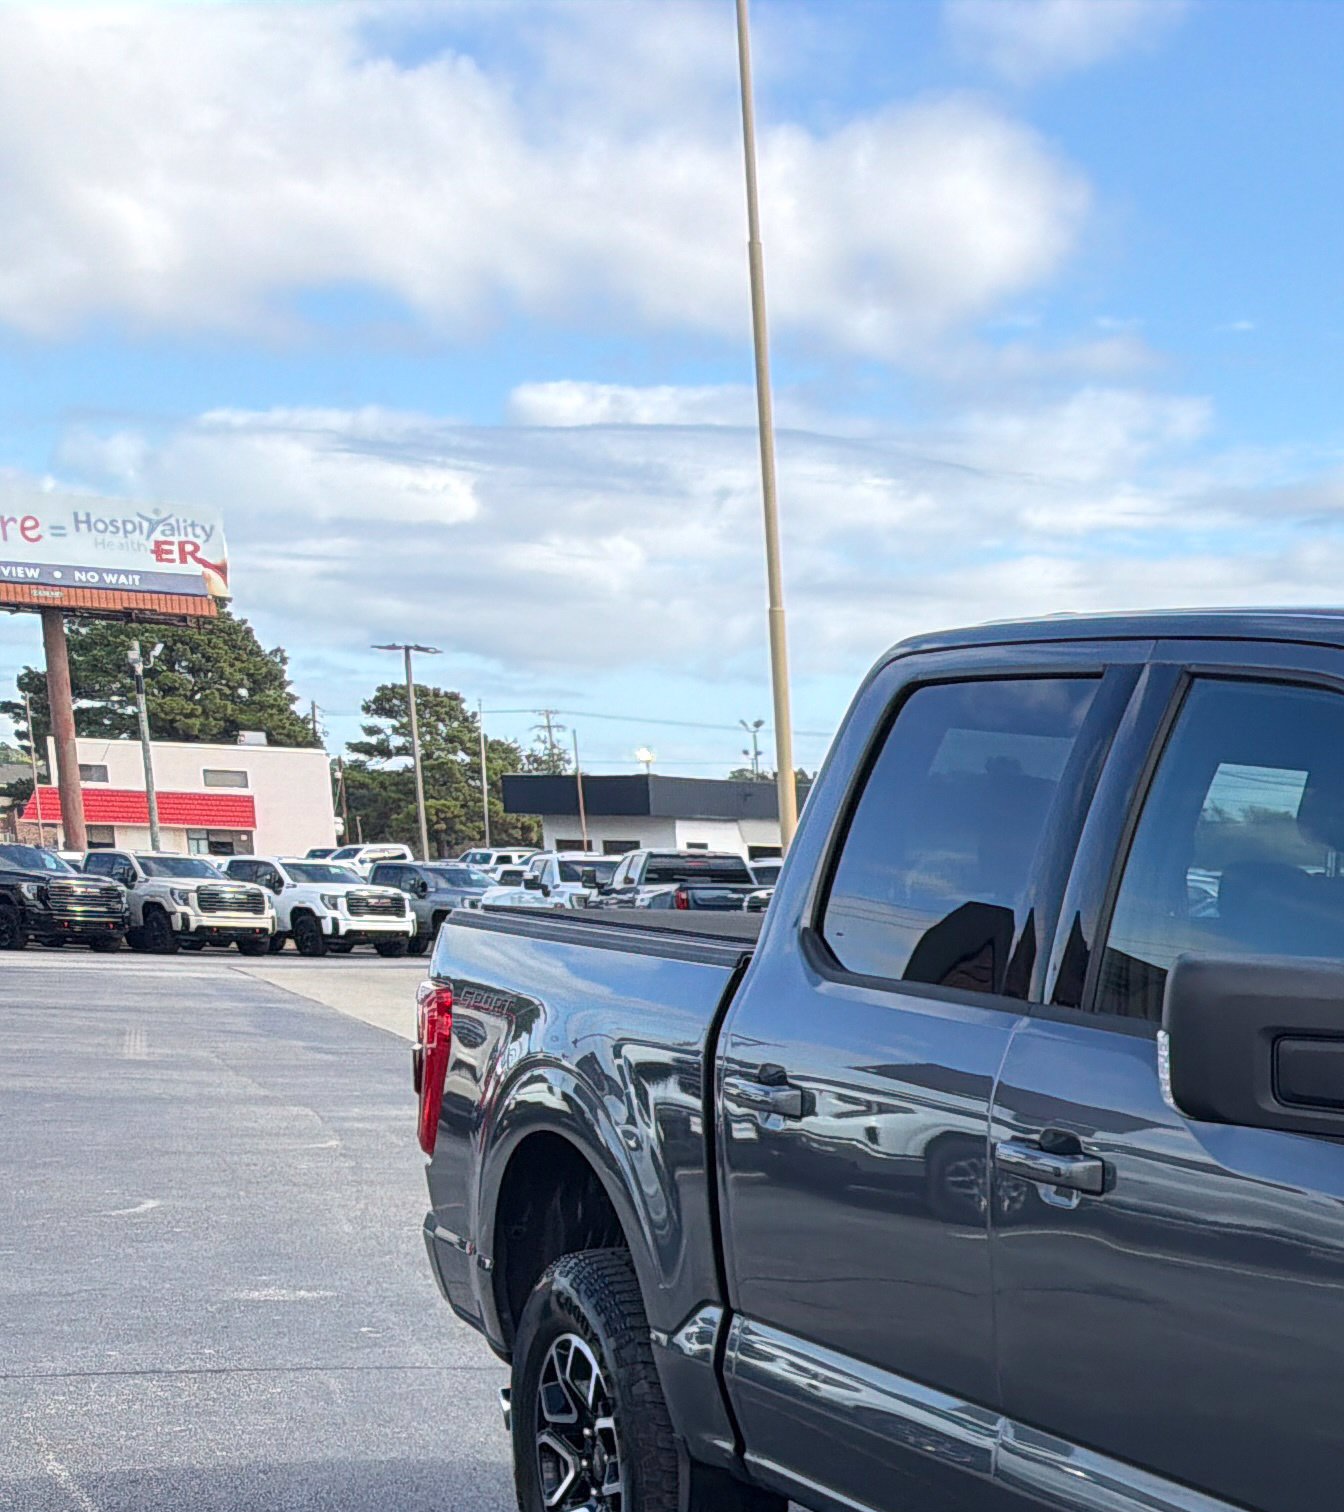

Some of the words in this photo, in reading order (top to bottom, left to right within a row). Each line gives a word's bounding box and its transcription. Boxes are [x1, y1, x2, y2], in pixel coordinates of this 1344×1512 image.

[150, 539, 203, 566] ER
[74, 570, 99, 583] NO
[103, 572, 141, 586] WAIT
